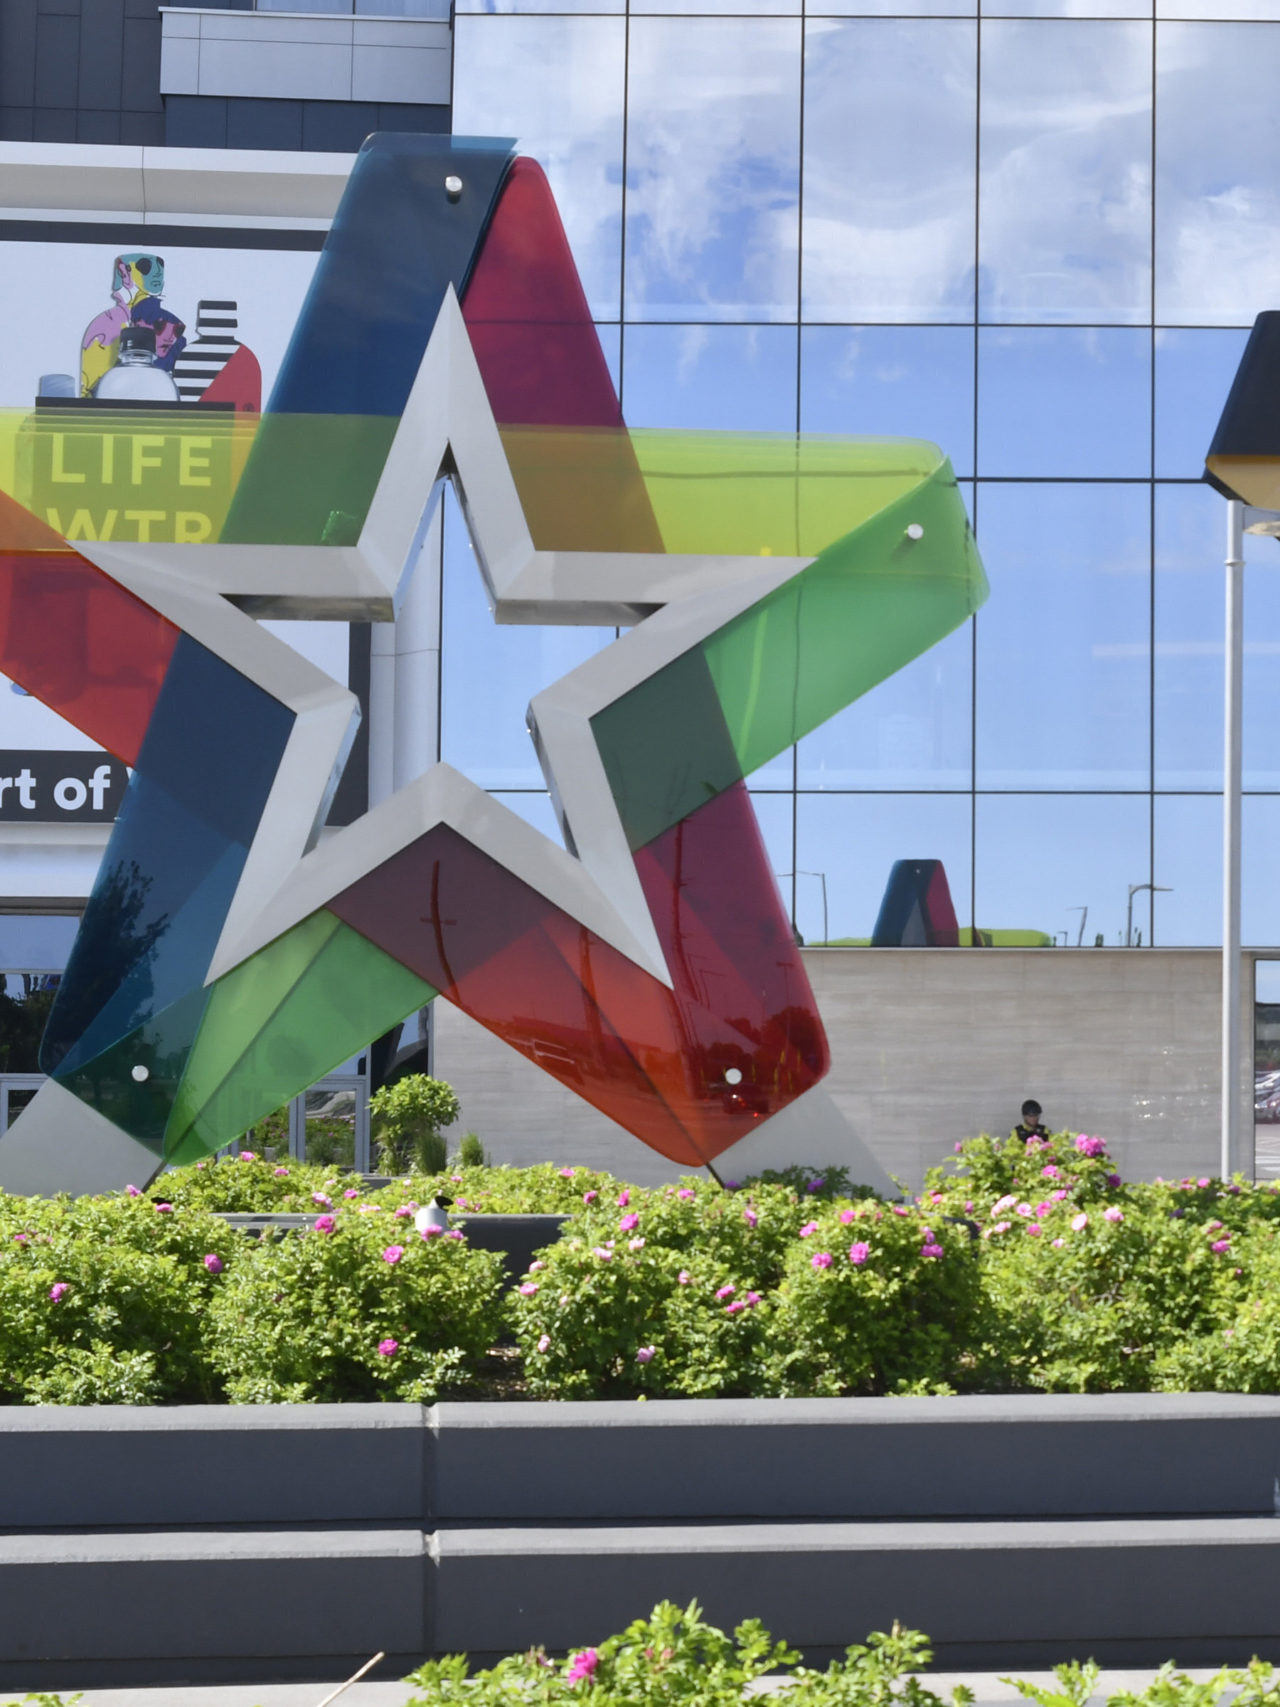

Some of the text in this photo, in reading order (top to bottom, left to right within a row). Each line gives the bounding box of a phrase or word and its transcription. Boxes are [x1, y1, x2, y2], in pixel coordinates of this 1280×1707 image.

[51, 433, 212, 486] LIFE
[46, 507, 212, 544] WTR
[53, 765, 111, 810] of
